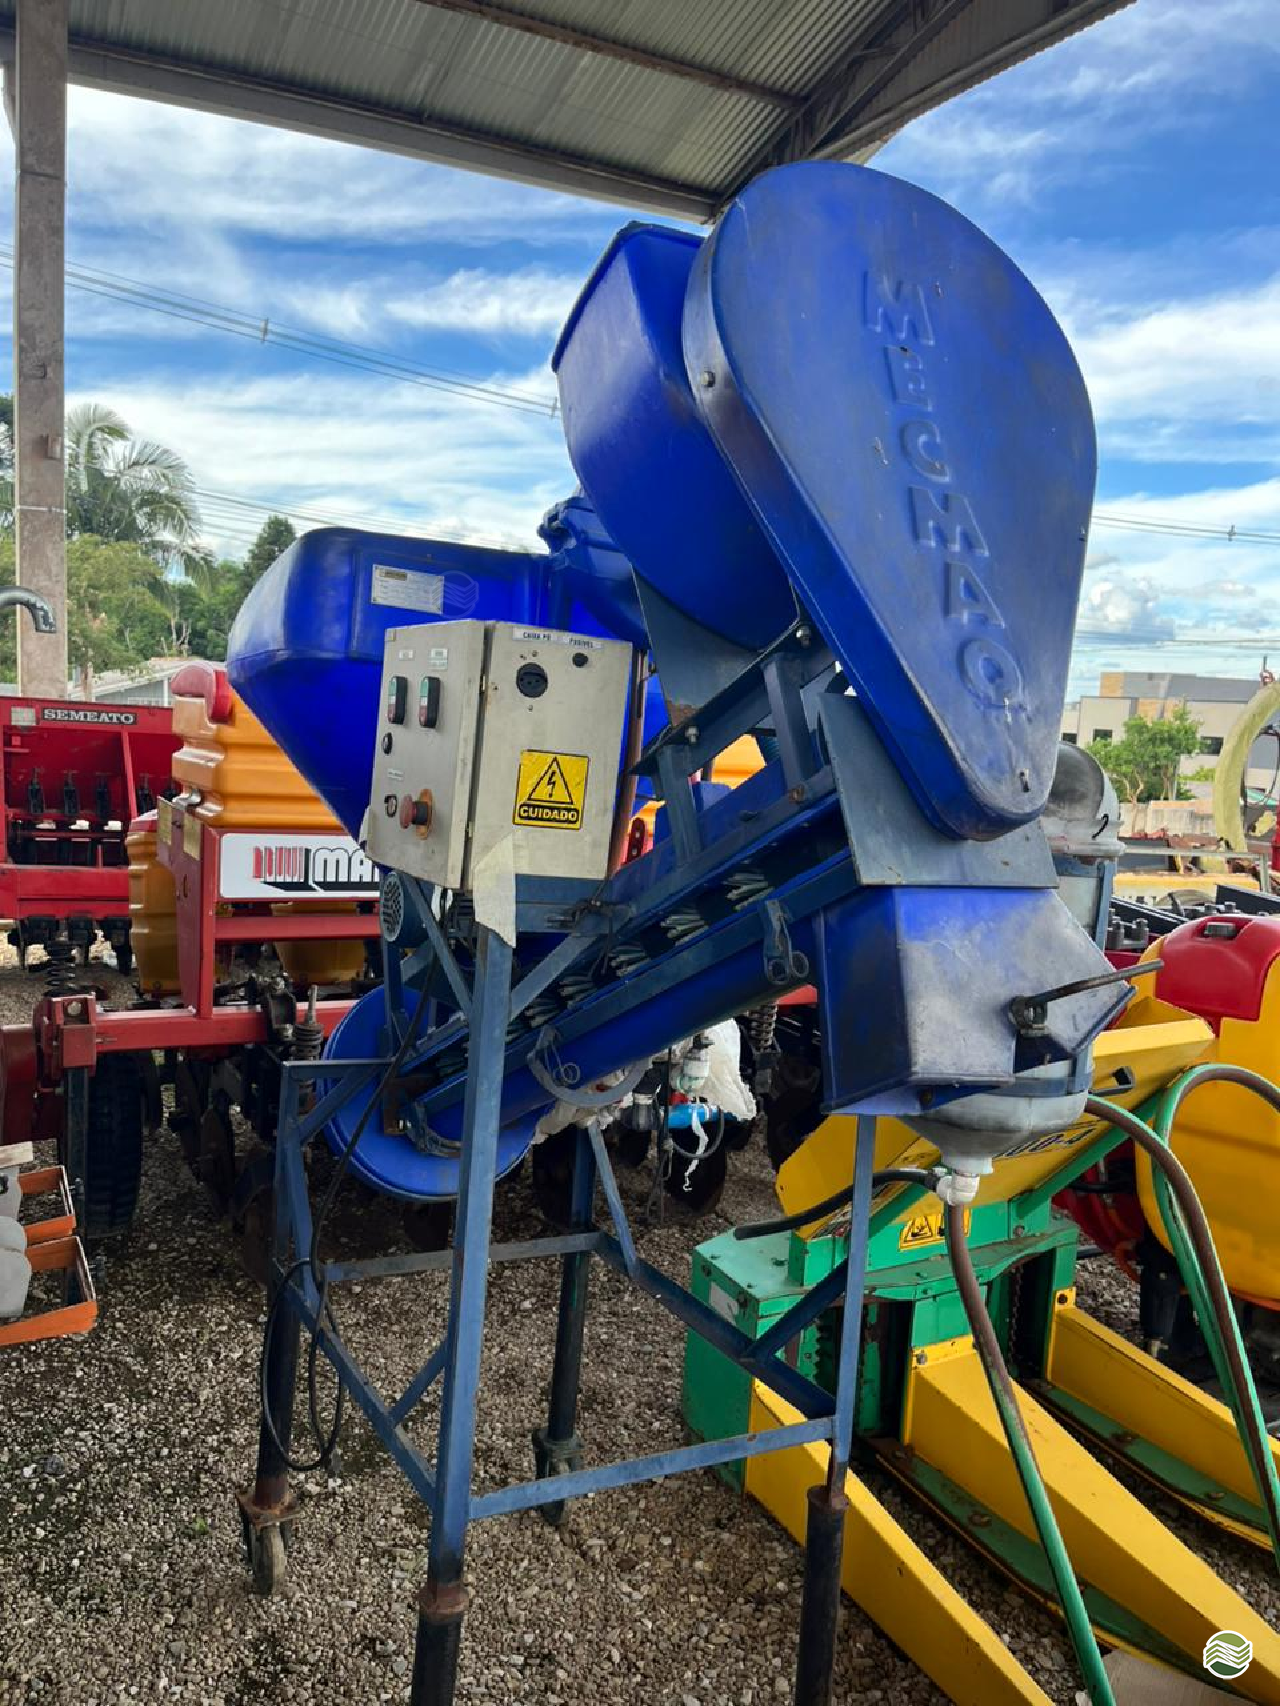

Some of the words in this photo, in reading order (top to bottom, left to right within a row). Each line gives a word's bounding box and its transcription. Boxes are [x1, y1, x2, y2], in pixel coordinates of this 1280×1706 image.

[863, 270, 1030, 714] MECMAQ
[43, 708, 134, 725] SEMEATO
[519, 805, 578, 822] CUIDADO
